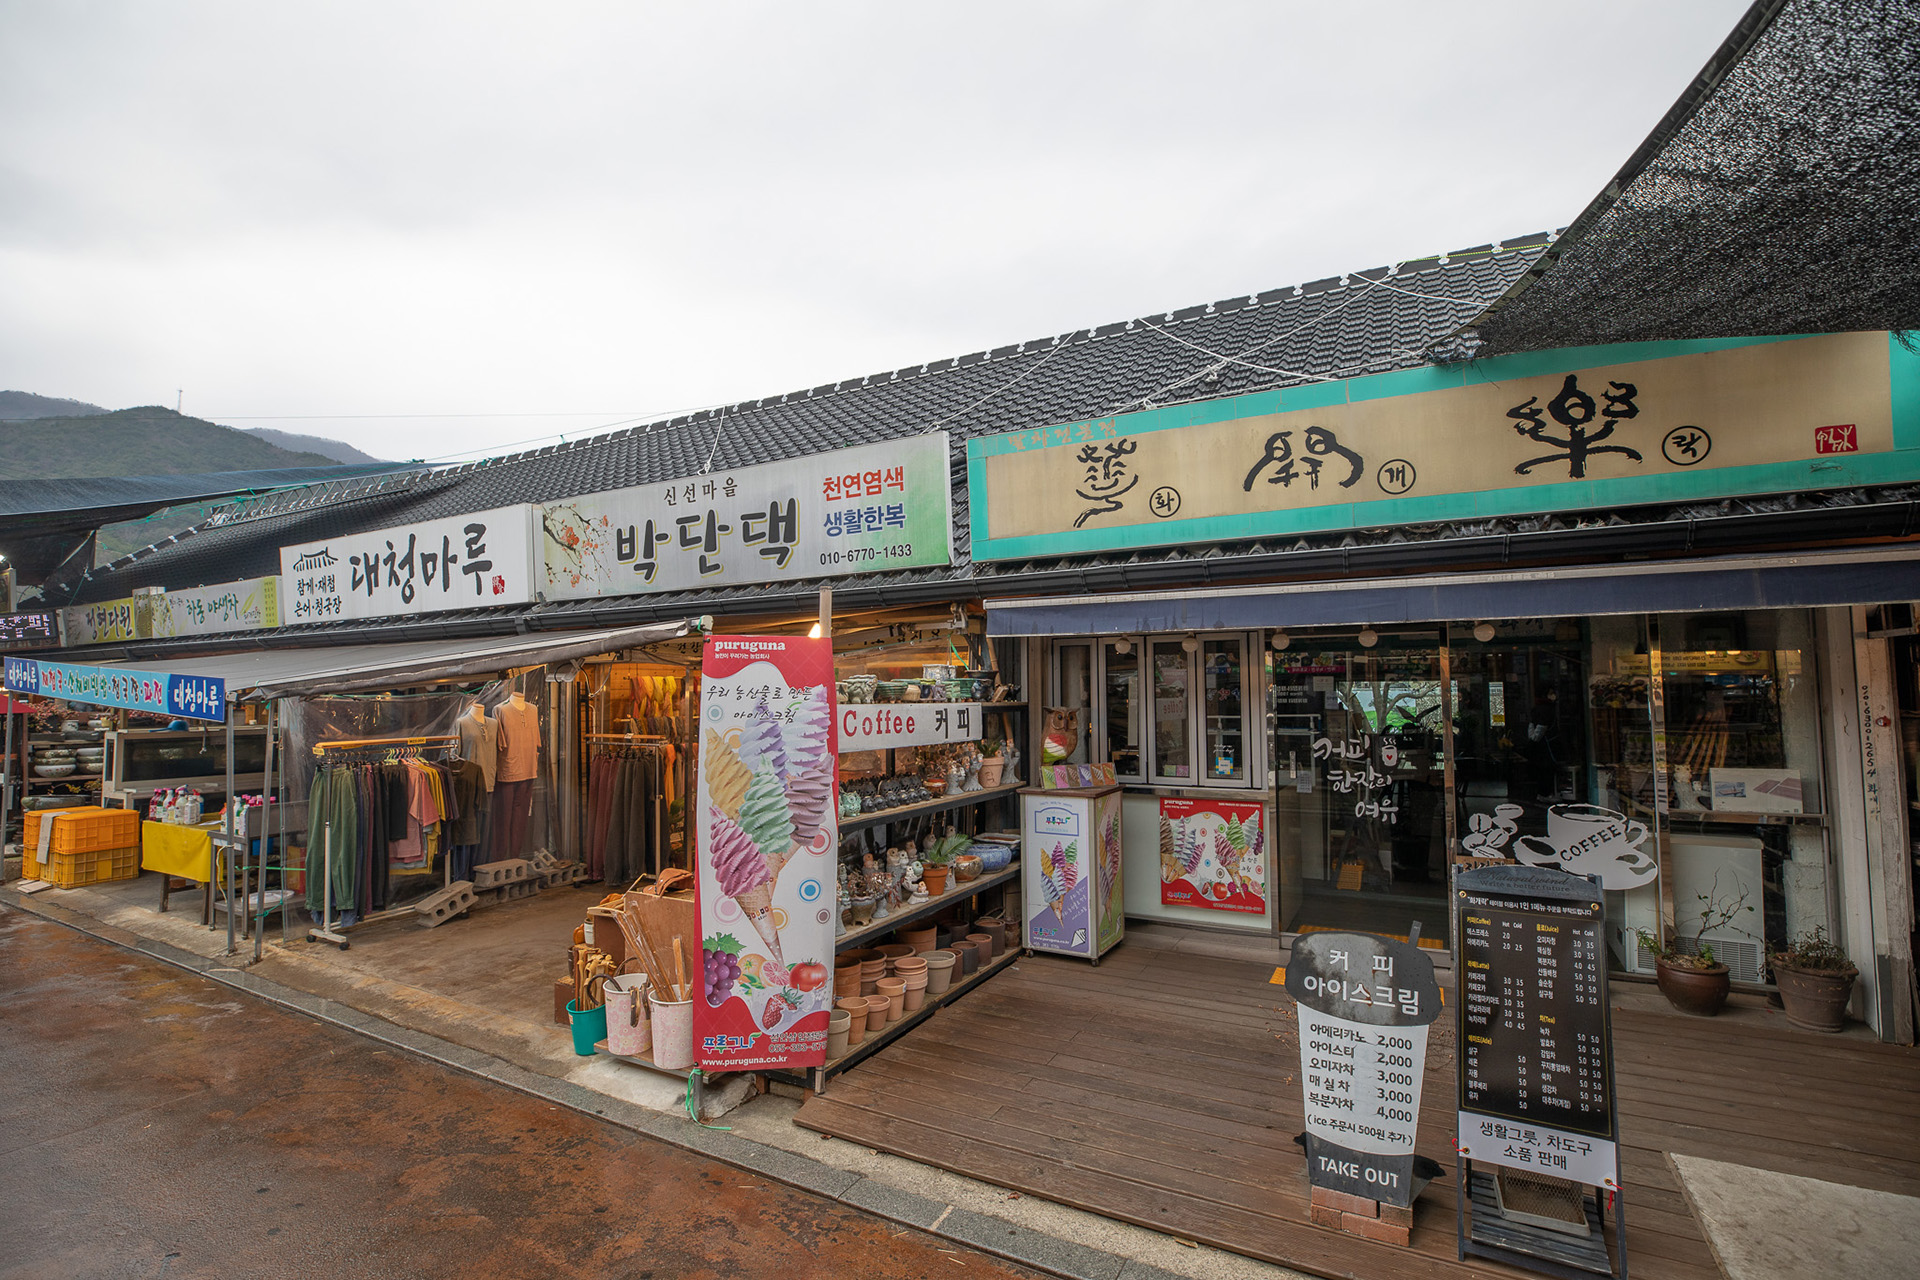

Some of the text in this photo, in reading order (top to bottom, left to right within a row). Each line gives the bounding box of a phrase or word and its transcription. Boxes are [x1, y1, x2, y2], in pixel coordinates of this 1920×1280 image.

[822, 465, 905, 502] 천연염색
[663, 476, 739, 507] 신선마을
[822, 503, 907, 538] 생활한복
[616, 497, 799, 583] 박단댁
[819, 544, 913, 566] 010-6770-1433
[349, 523, 493, 604] 대청마루
[714, 641, 786, 652] puruguna
[173, 678, 220, 715] 대청마루
[706, 684, 813, 706] 우리 농산물로 만든
[733, 707, 797, 725] 아이스크림
[843, 707, 971, 739] Coffee 커피
[1312, 734, 1370, 760] 커피
[1355, 798, 1399, 824] 여유
[1559, 824, 1622, 861] COFFEE
[1478, 871, 1535, 884] Natural
[1542, 884, 1570, 892] future
[1520, 902, 1529, 910] 1인
[1530, 903, 1546, 912] 1메뉴
[1466, 928, 1489, 937] 에스프레소
[1466, 938, 1490, 948] 아메리카노
[1573, 940, 1581, 948] 3.0
[1586, 941, 1594, 949] 3.5
[1587, 952, 1595, 960] 3.5
[1329, 949, 1394, 978] 커피
[1574, 962, 1582, 970] 4.0
[1587, 963, 1596, 971] 4.5
[1504, 976, 1512, 985] 3.0
[1516, 978, 1524, 986] 3.5
[1504, 987, 1512, 995] 3.0
[1516, 989, 1524, 997] 3.5
[1575, 984, 1584, 992] 5.0
[1588, 986, 1597, 994] 5.0
[1304, 975, 1420, 1016] 아이스크림
[1576, 995, 1584, 1003] 5.0
[1589, 997, 1598, 1005] 5.0
[1504, 998, 1525, 1008] 3.0 3.5
[1504, 1009, 1512, 1017] 3.0
[1517, 1011, 1525, 1019] 3.5
[1504, 1020, 1513, 1028] 4.0
[1517, 1022, 1525, 1030] 4.5
[1310, 1023, 1413, 1050] 아메리카노 2,000
[1577, 1033, 1586, 1042] 5.0
[1590, 1035, 1599, 1044] 5.0
[1309, 1040, 1413, 1068] 아이스티 2,000
[1577, 1045, 1586, 1053] 5.0
[1591, 1047, 1600, 1055] 5.0
[701, 1055, 788, 1067] www.puruguna.co.kr
[1518, 1055, 1526, 1063] 5.0
[1578, 1056, 1587, 1065] 5.0
[1592, 1059, 1601, 1067] 5.0
[1309, 1057, 1413, 1086] 오미자차 3,000
[1518, 1066, 1527, 1075] 5.0
[1579, 1068, 1588, 1076] 5.0
[1592, 1070, 1601, 1079] 5.0
[1518, 1078, 1527, 1086] 5.0
[1580, 1079, 1588, 1088] 5.0
[1593, 1082, 1602, 1091] 5.0
[1377, 1088, 1413, 1104] 3,000
[1519, 1089, 1527, 1098] 5.0
[1580, 1091, 1589, 1100] 5.0
[1593, 1094, 1603, 1103] 5.0
[1308, 1092, 1413, 1123] 복분자차 4,000
[1519, 1101, 1528, 1109] 5.0
[1580, 1103, 1589, 1112] 5.0
[1329, 1118, 1356, 1133] 주문시
[1358, 1125, 1385, 1140] 500원
[1479, 1121, 1593, 1156] 생활그릇, 차도구
[1503, 1144, 1567, 1170] 소품 판매
[1318, 1156, 1399, 1188] TAKE OUT
